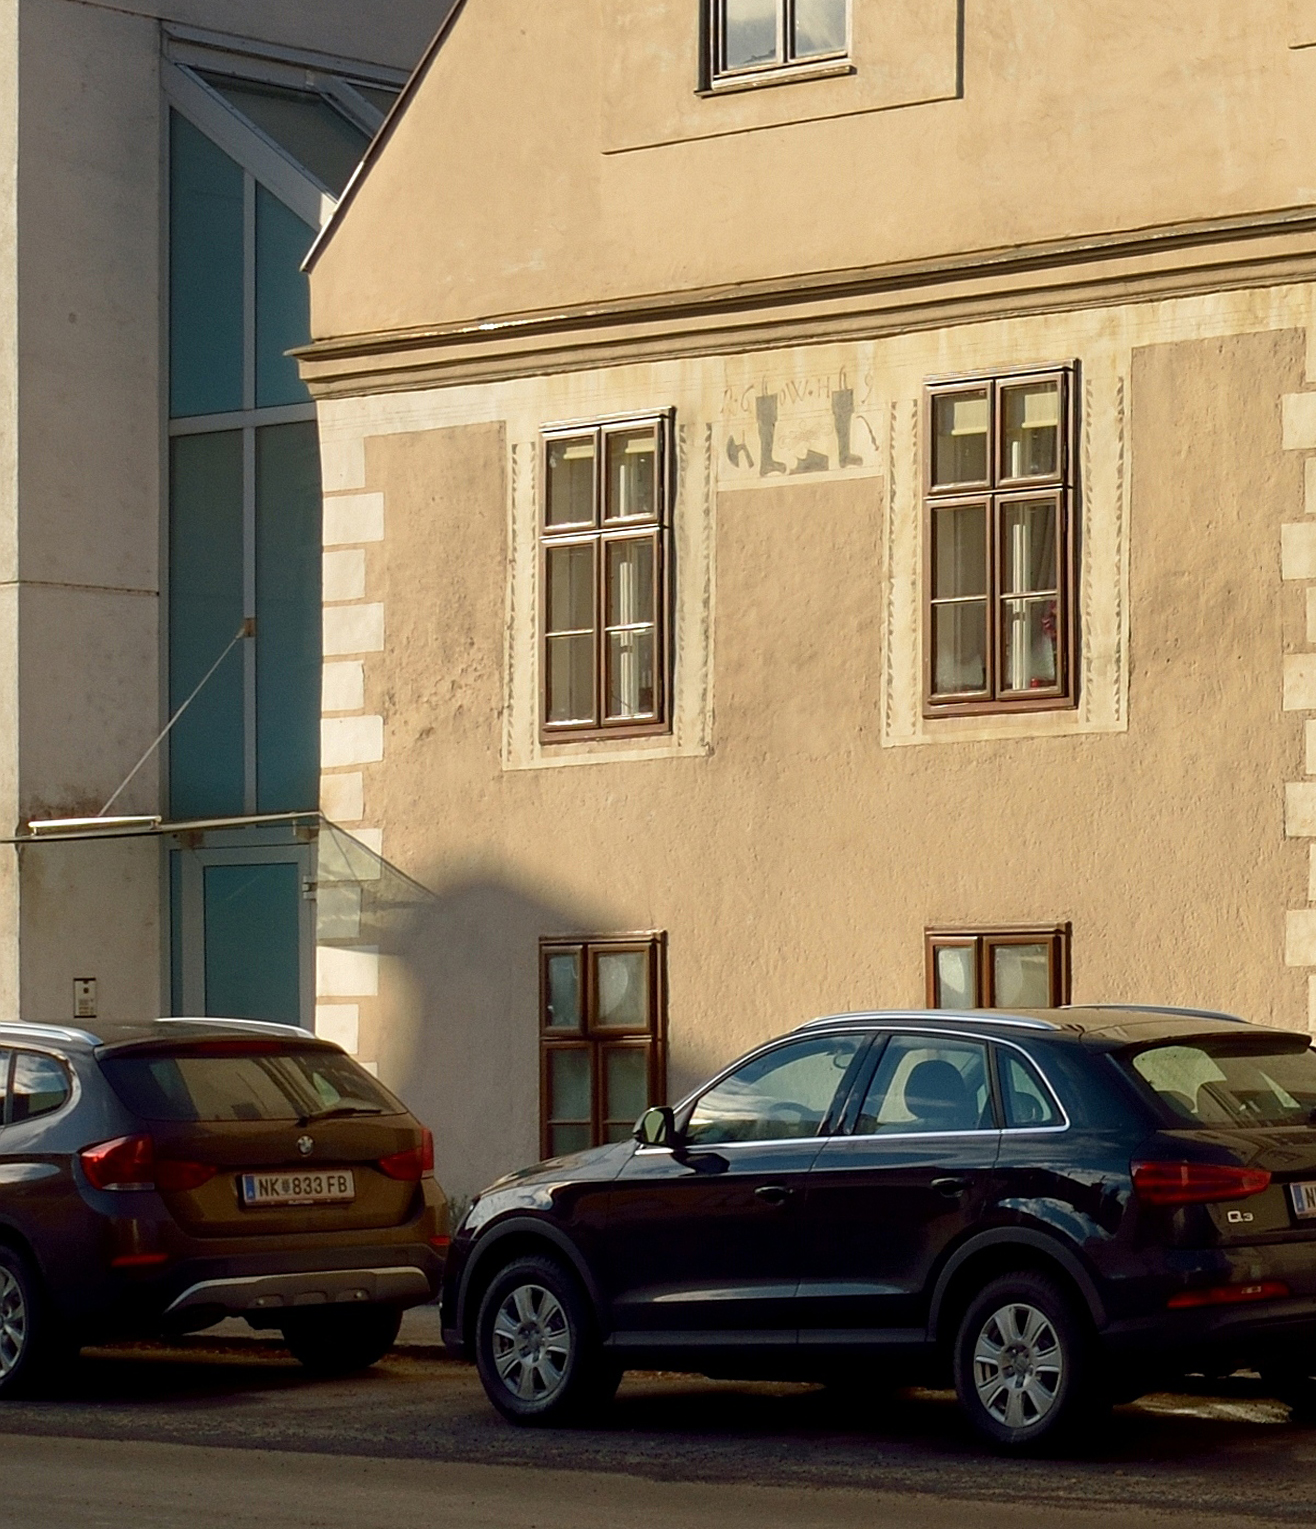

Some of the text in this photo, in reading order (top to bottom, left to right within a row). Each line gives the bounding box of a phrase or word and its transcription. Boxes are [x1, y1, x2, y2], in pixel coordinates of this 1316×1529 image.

[259, 1175, 348, 1197] NK 833 FB
[1227, 1210, 1254, 1223] Q3
